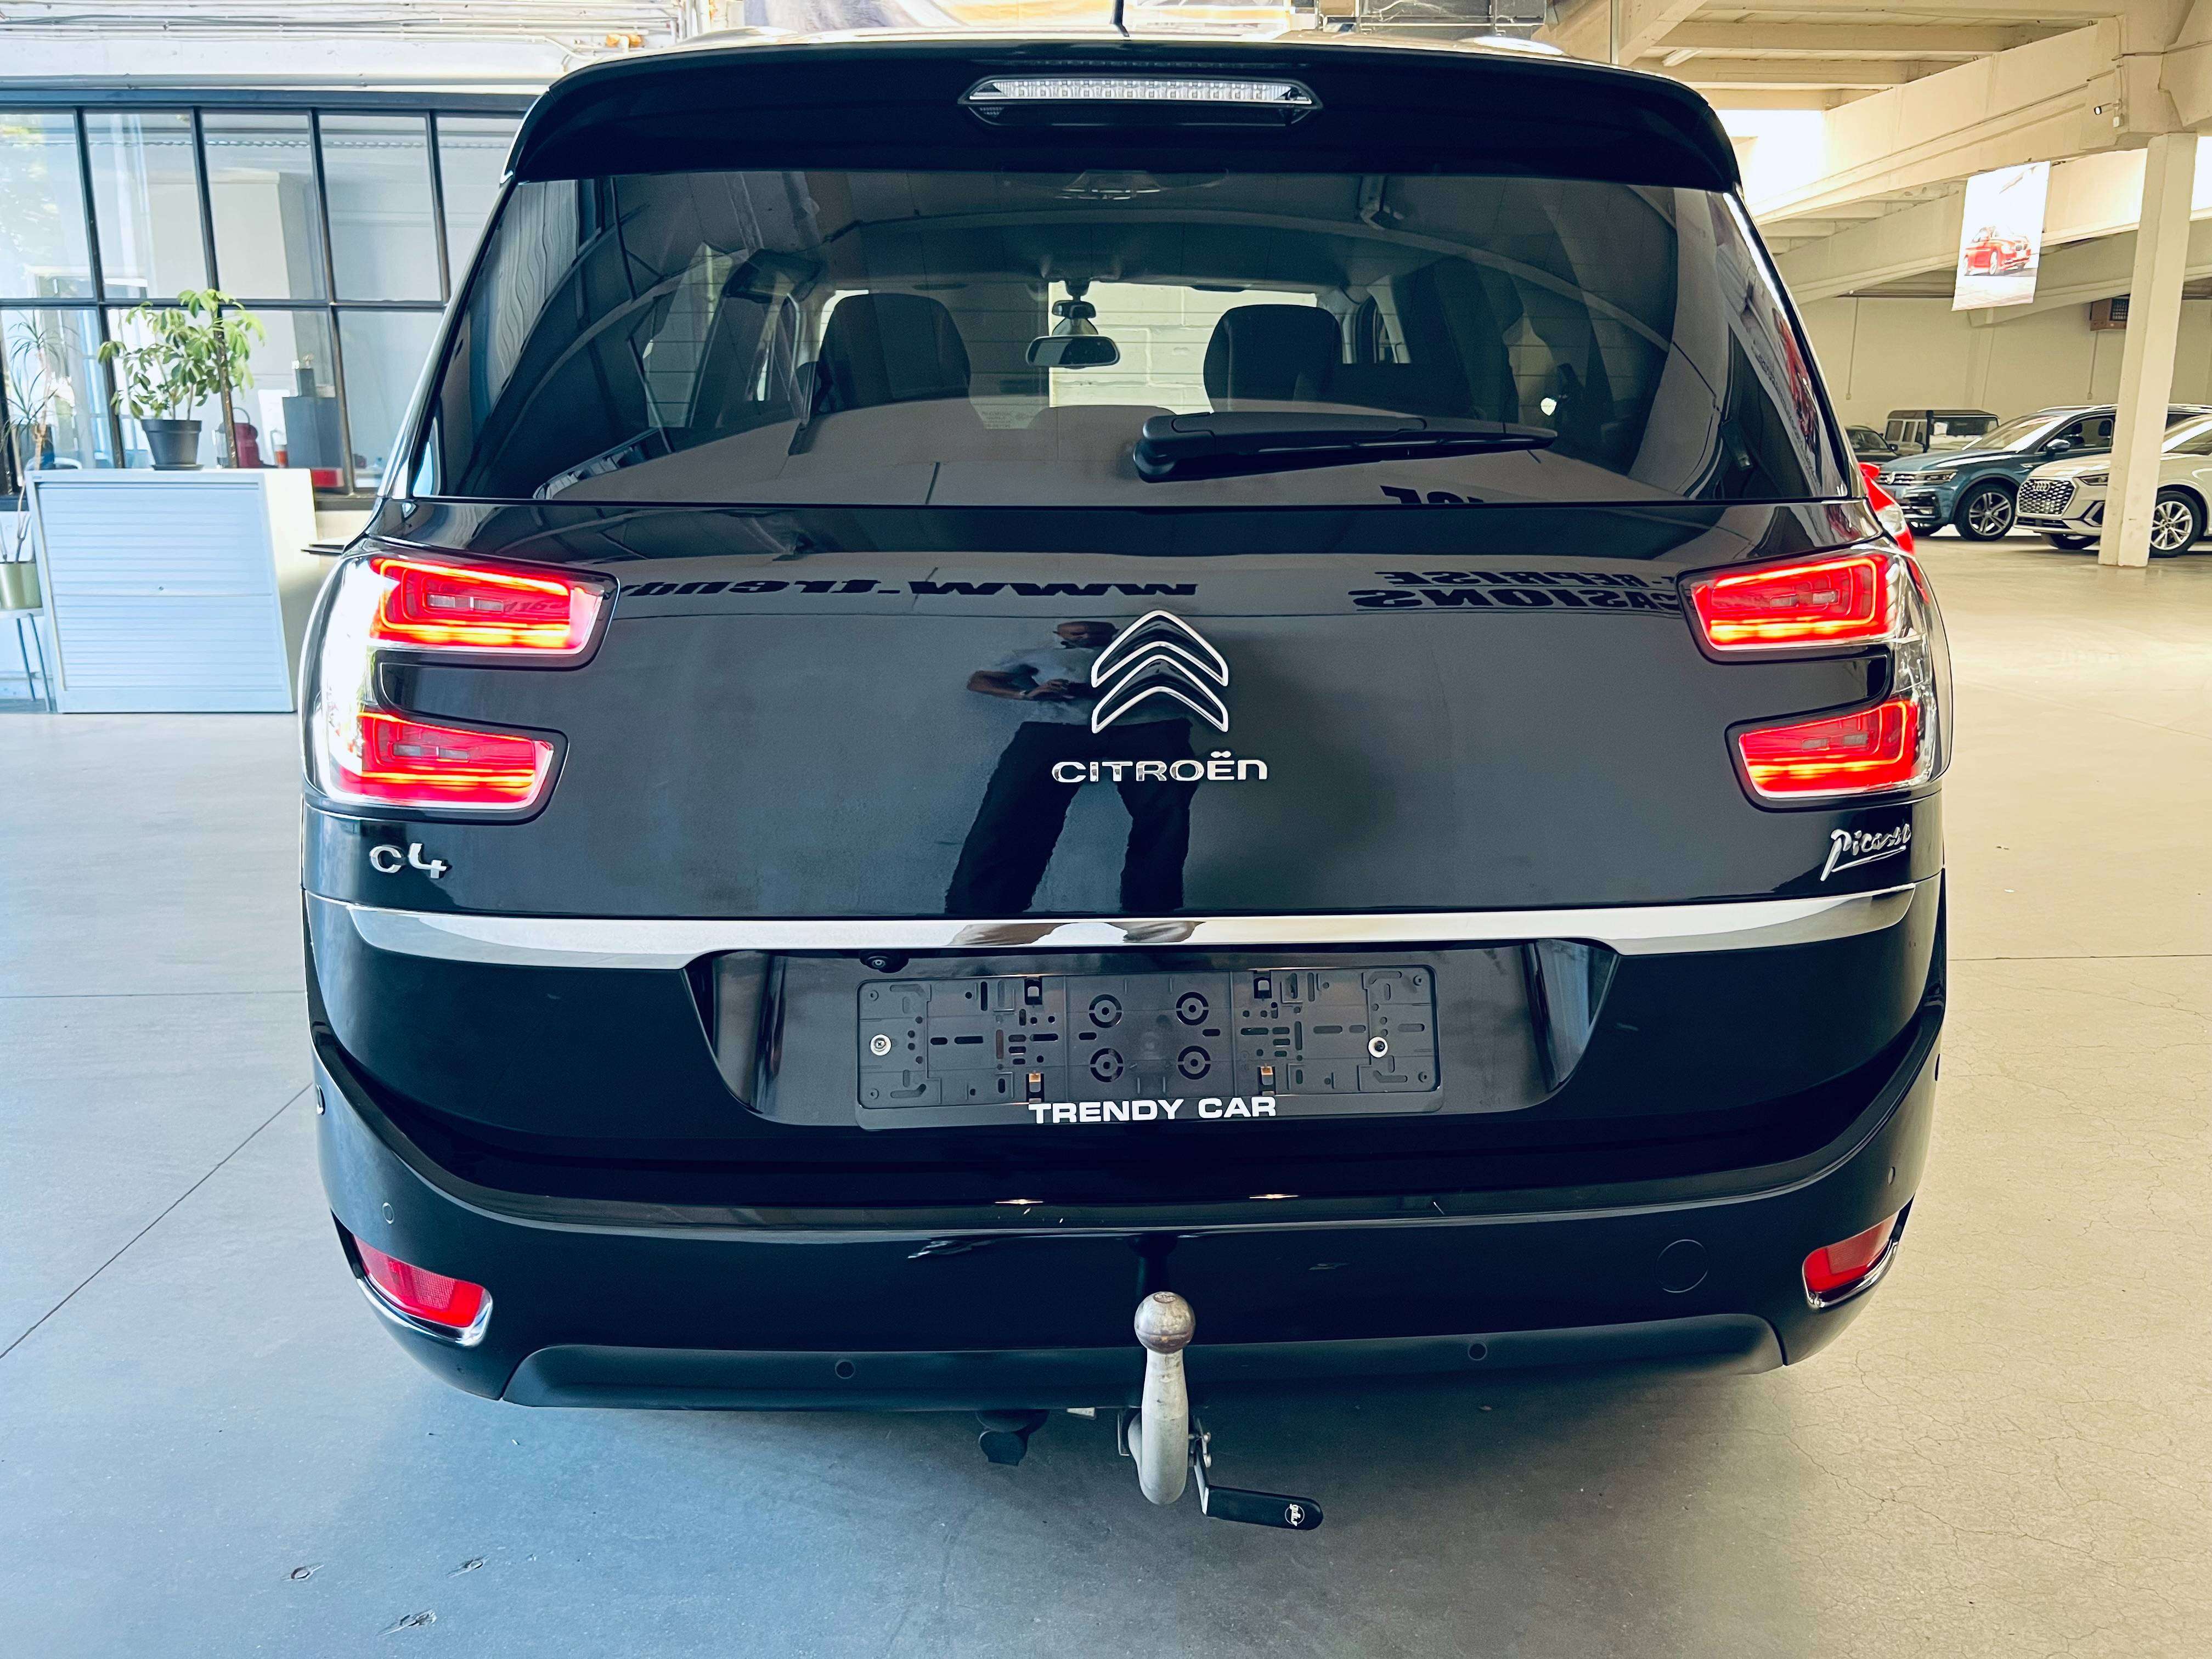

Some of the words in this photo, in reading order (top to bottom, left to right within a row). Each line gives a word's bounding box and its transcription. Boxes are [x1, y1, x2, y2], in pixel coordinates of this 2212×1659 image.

[369, 842, 447, 879] C4
[1820, 823, 1912, 882] Picasso
[1028, 1099, 1184, 1124] TRENDY
[1198, 1096, 1276, 1119] CAR
